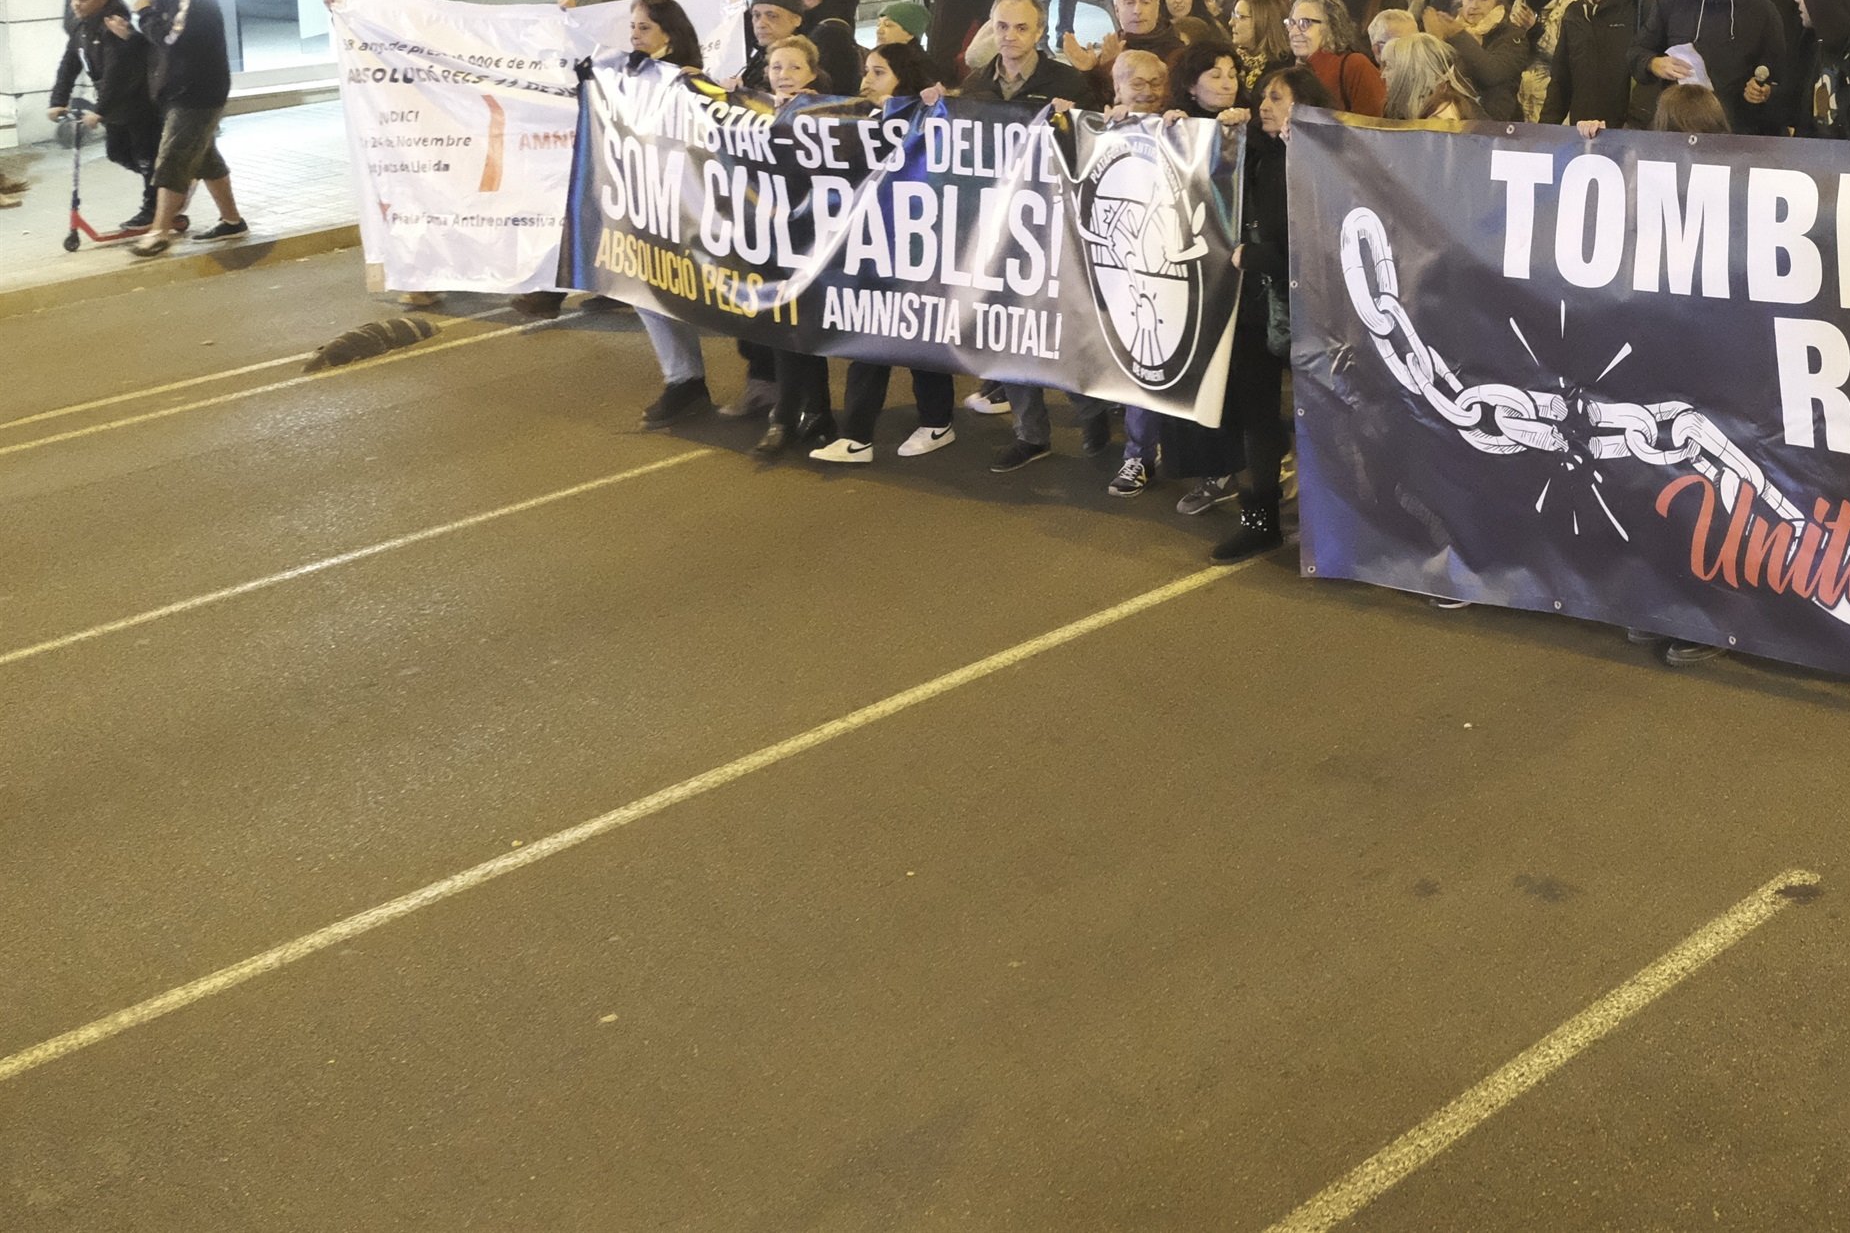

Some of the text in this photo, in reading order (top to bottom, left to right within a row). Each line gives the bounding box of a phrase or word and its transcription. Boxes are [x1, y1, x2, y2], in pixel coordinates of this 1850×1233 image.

[601, 124, 686, 245] SOM
[701, 159, 1065, 299] CULPABLES!
[594, 227, 698, 302] ABSOLUCIÓ
[702, 262, 765, 319] PELS
[822, 285, 1063, 360] AMNISTIA TOTAL!
